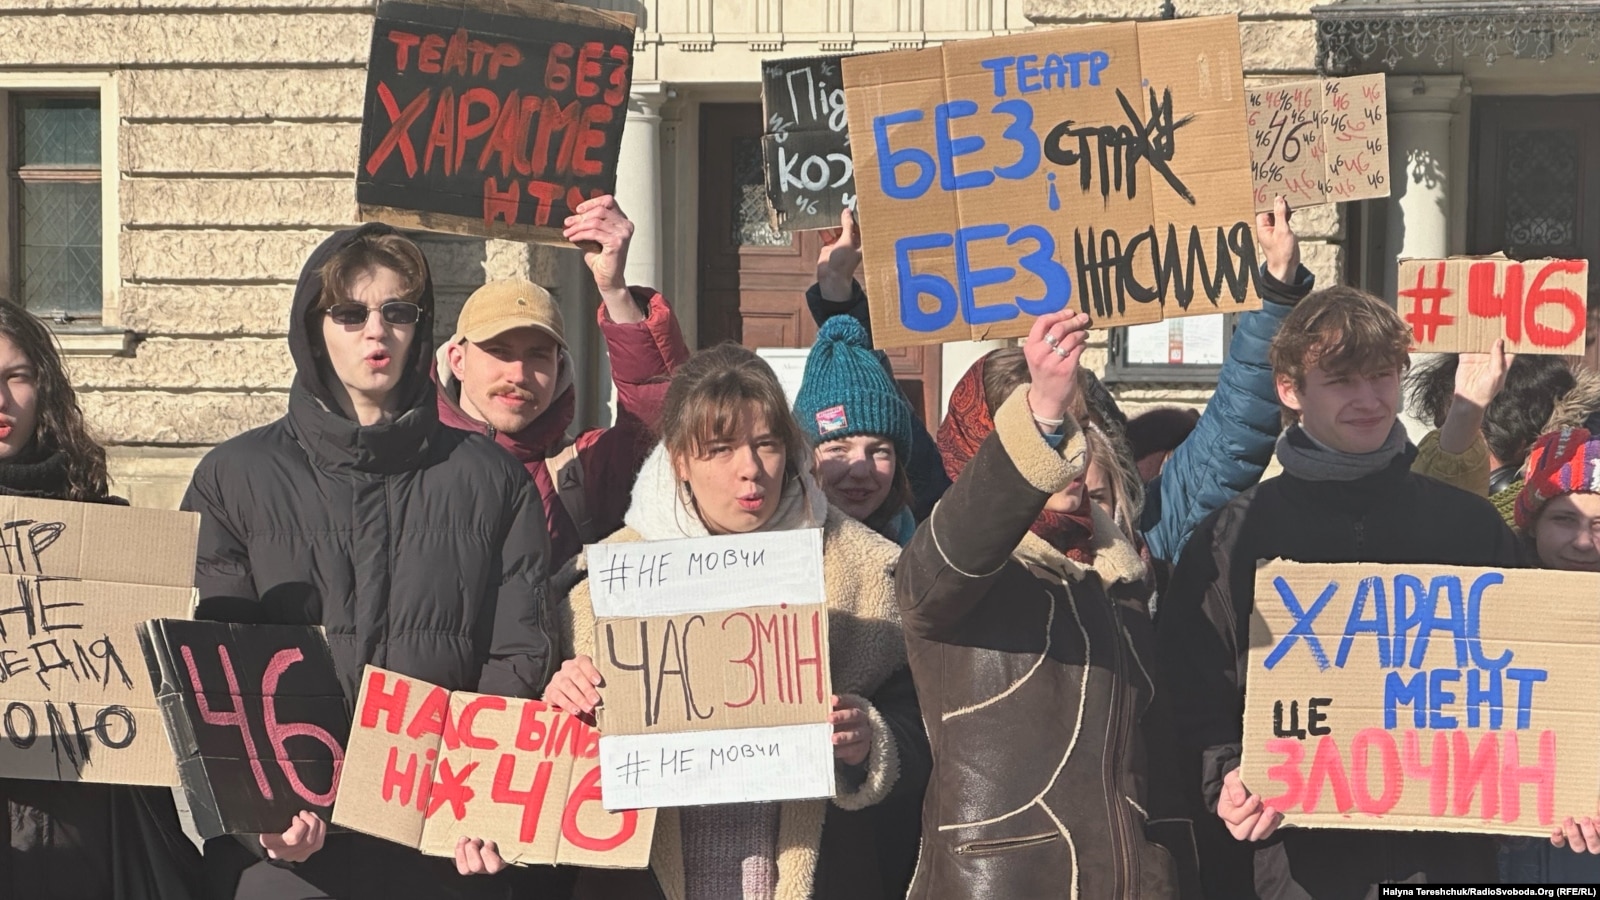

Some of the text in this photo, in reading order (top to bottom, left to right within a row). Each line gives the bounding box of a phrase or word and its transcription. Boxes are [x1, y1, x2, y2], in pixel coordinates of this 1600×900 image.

[388, 27, 629, 106] ТЕАТР БЕЗ
[982, 51, 1109, 96] ТЕАТР
[1250, 94, 1261, 107] 46
[1280, 90, 1293, 111] 46
[1326, 82, 1340, 96] 46
[366, 80, 613, 178] ХАРАСМЕ
[1268, 110, 1313, 162] 46
[1291, 109, 1305, 124] 46
[1312, 110, 1328, 129] 46
[1331, 114, 1348, 134] 46
[1364, 105, 1382, 125] 46
[873, 99, 1040, 199] БЕЗ
[1255, 130, 1272, 147] 46
[1303, 131, 1316, 146] 46
[1366, 138, 1382, 155] 46
[1251, 161, 1268, 180] 46
[1267, 162, 1285, 183] 46
[1318, 179, 1332, 195] 46
[1367, 170, 1384, 189] 46
[896, 224, 1071, 332] БЕЗ
[1398, 260, 1586, 349] #46
[1264, 571, 1515, 672] ХАРАС
[606, 602, 823, 727] ЧАС ЗМІН
[361, 672, 506, 750] НАС
[1273, 697, 1333, 740] ЦЕ
[1384, 668, 1549, 730] МЕНТ
[181, 644, 344, 806] 46
[1263, 728, 1557, 827] ЗЛОЧИН
[490, 753, 638, 852] 46
